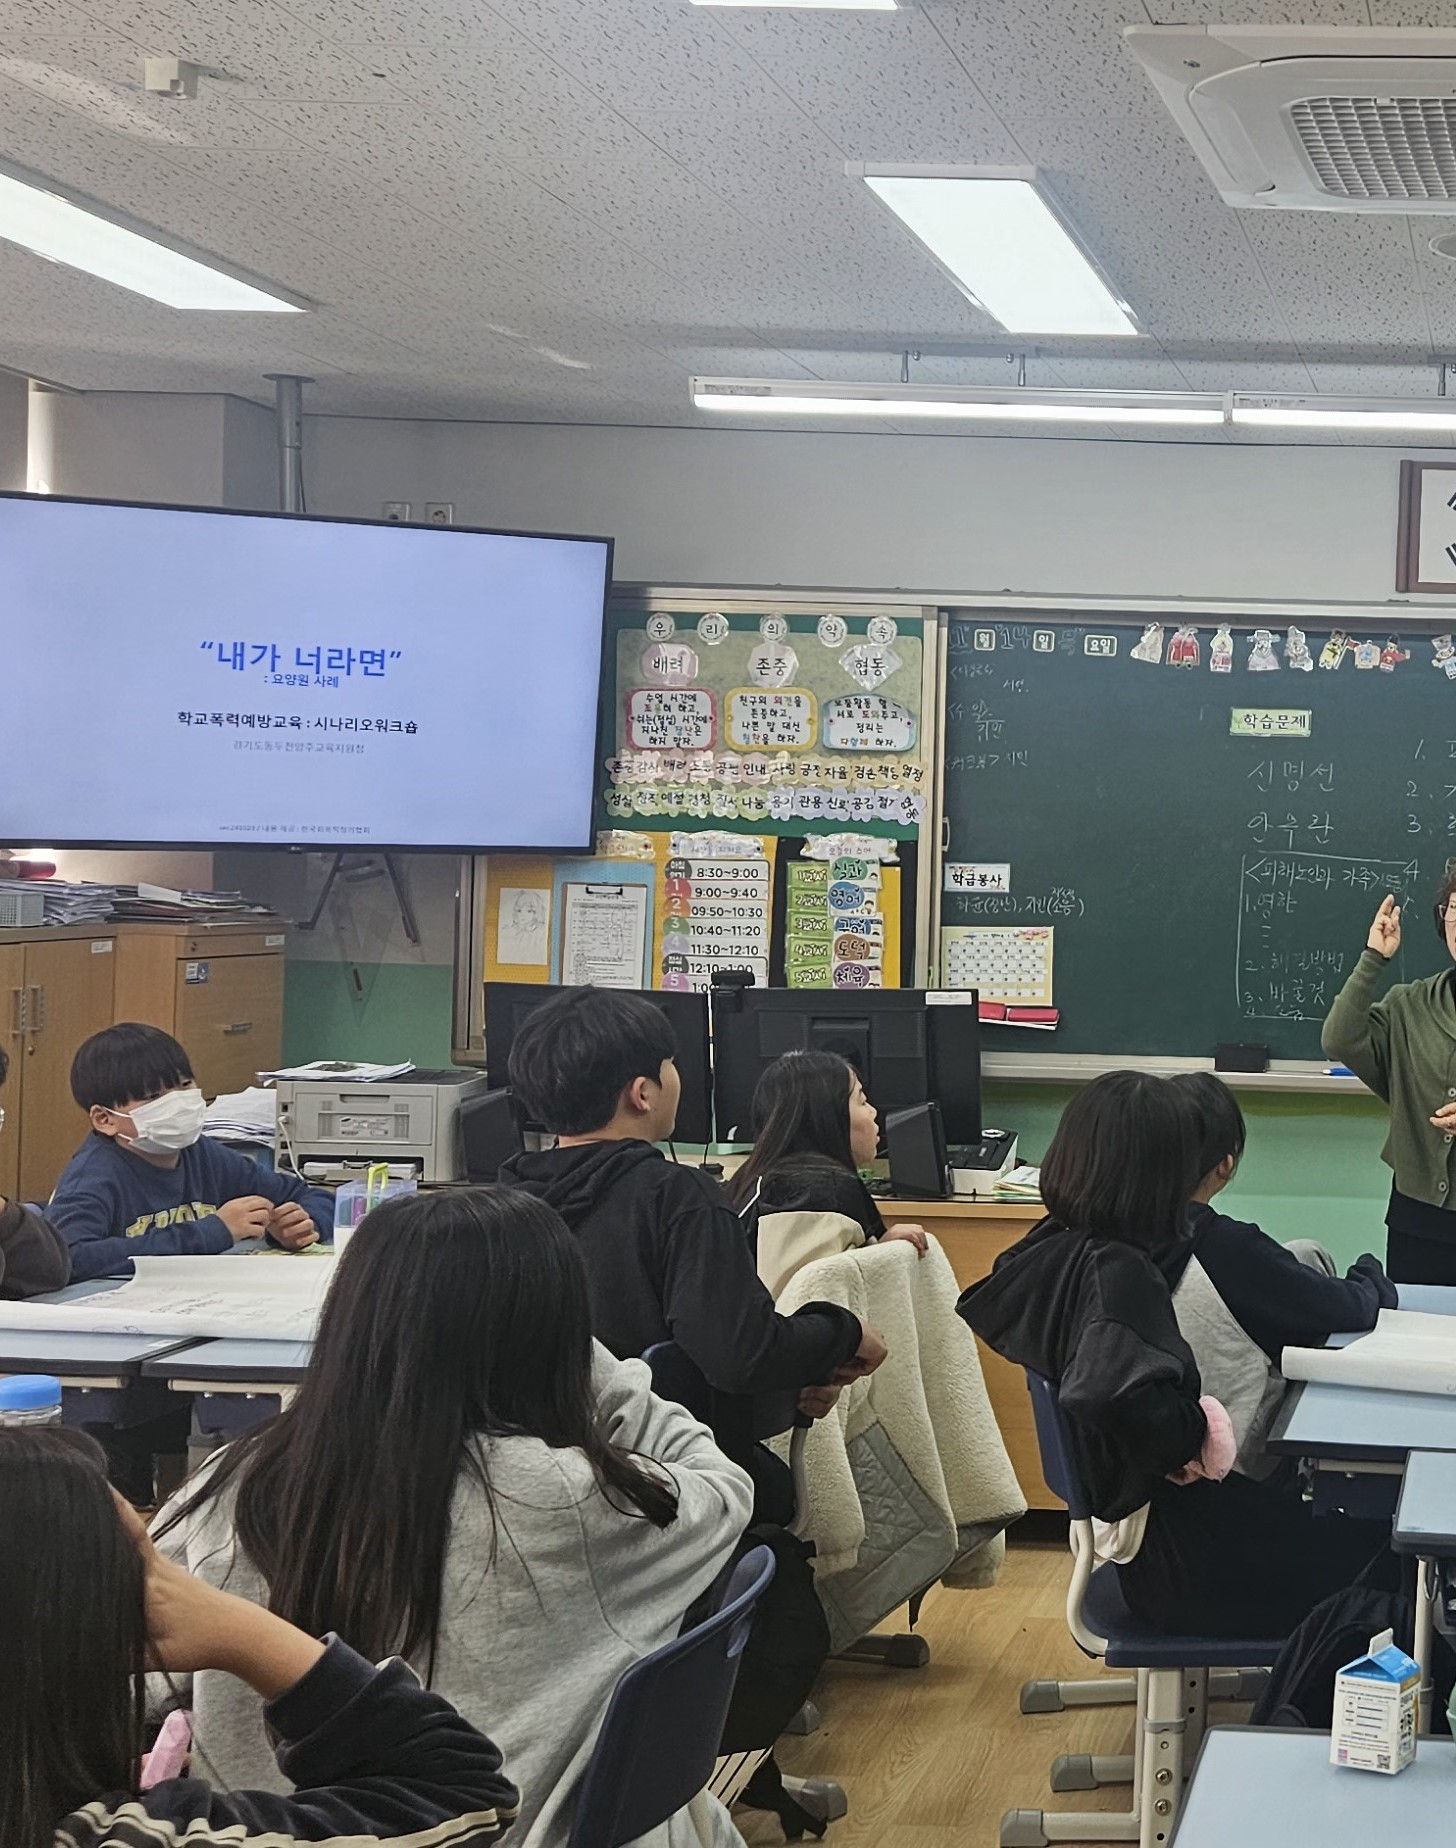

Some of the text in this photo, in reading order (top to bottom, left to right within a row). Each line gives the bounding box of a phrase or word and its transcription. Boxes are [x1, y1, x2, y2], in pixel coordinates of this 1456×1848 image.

[1038, 634, 1050, 649] 일
[1090, 638, 1112, 654] 요일
[653, 656, 683, 673] 배려
[756, 658, 788, 676] 존중
[855, 657, 886, 676] 협동
[272, 673, 339, 688] 요양원 사례
[646, 693, 697, 704] 수업 시간에
[177, 711, 419, 734] 학교폭력예방교육 시나리오워크숍
[767, 721, 776, 732] 말
[856, 723, 884, 734] 정리는
[1243, 713, 1306, 730] 학습문제
[649, 736, 695, 747] 하지 말자.
[777, 734, 800, 744] 하자.
[875, 738, 897, 748] 하자.
[743, 763, 767, 776] 인내
[799, 796, 823, 809] 관용
[697, 868, 759, 878] 8:30~9:00
[952, 872, 1002, 887] 학급봉사
[673, 879, 758, 898] 1 9:00~9:40
[831, 889, 861, 907] 영어
[672, 898, 763, 918] 2 09:50~10:30
[671, 918, 761, 936] 3 10:40~11:20
[691, 944, 759, 956] 11:30~12:10
[837, 941, 866, 959] 도덕
[670, 974, 680, 986] 5
[836, 967, 864, 987] 체육
